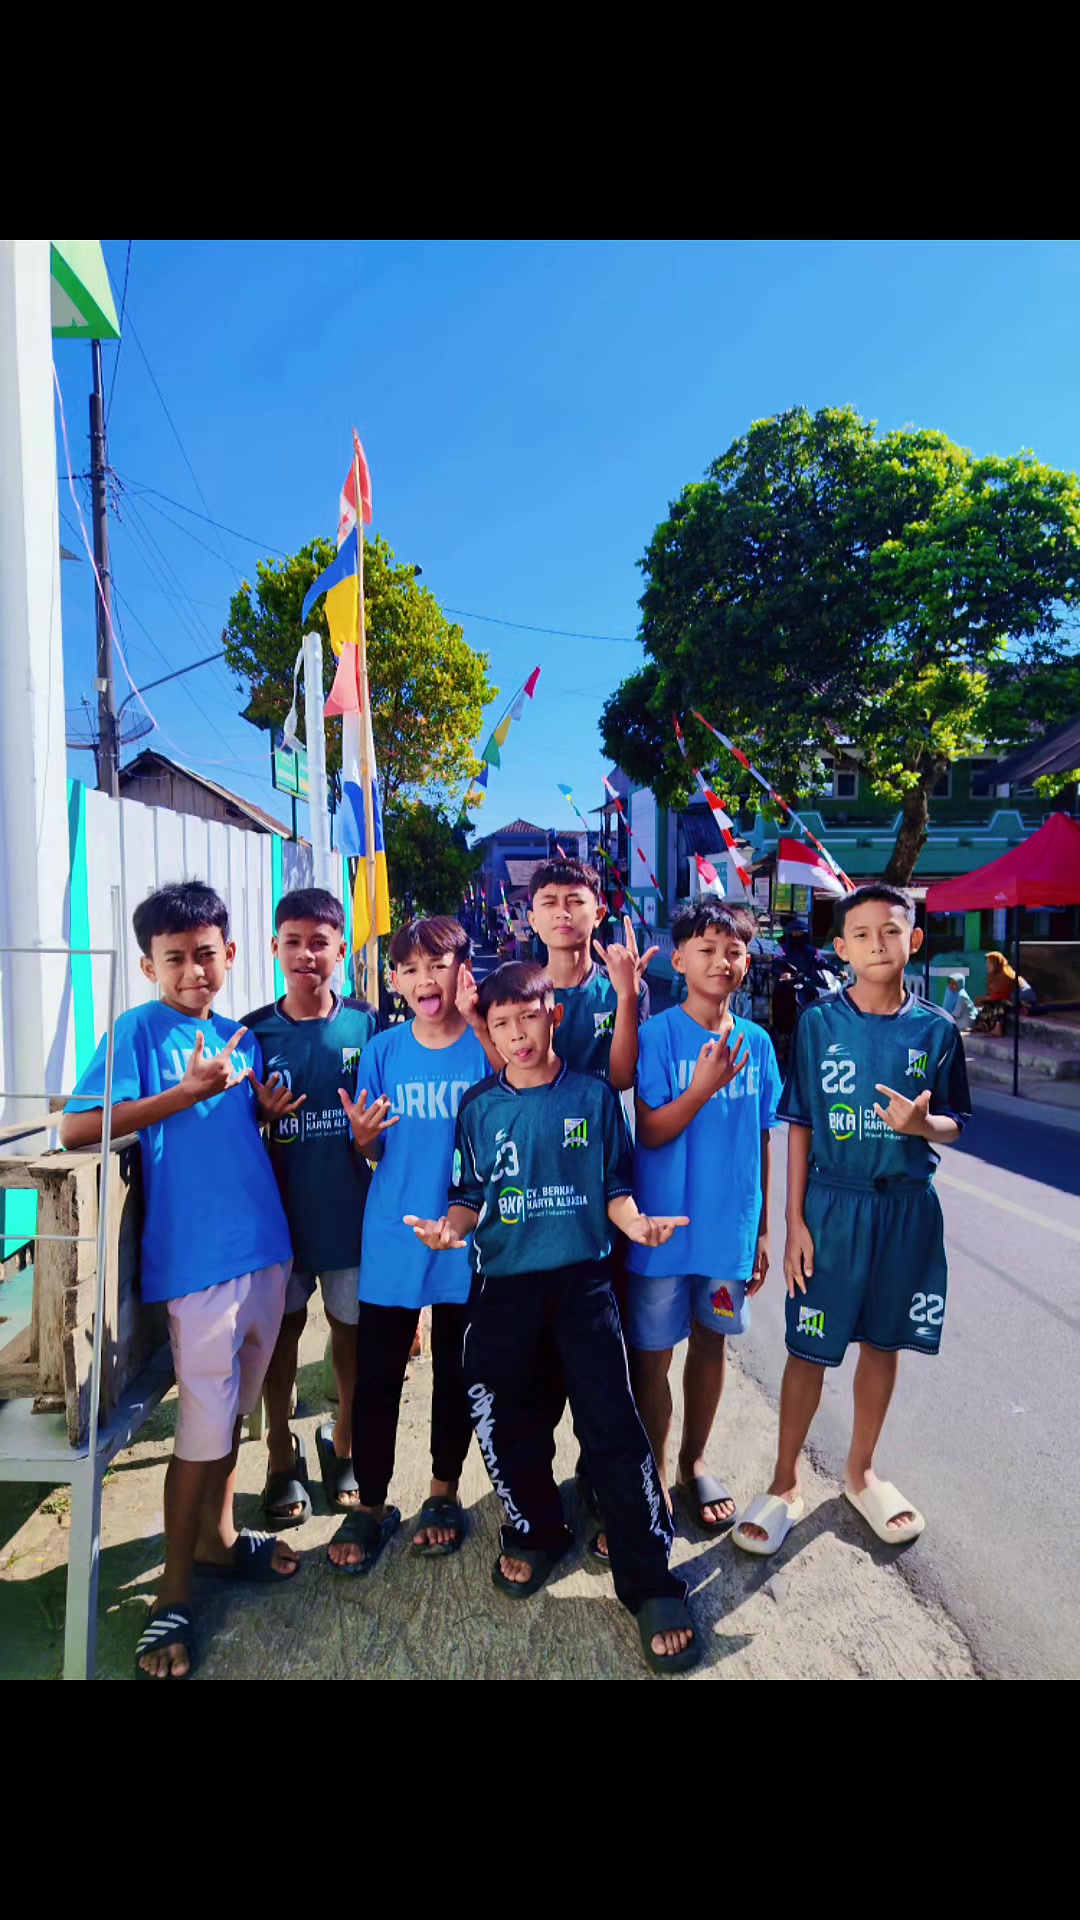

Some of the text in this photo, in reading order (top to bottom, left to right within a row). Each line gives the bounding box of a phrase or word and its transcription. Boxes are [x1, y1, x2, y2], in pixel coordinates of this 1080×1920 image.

[821, 1060, 856, 1094] 22
[279, 1117, 299, 1135] KA
[829, 1112, 856, 1131] BKA
[490, 1141, 520, 1182] 23
[909, 1292, 944, 1325] 22
